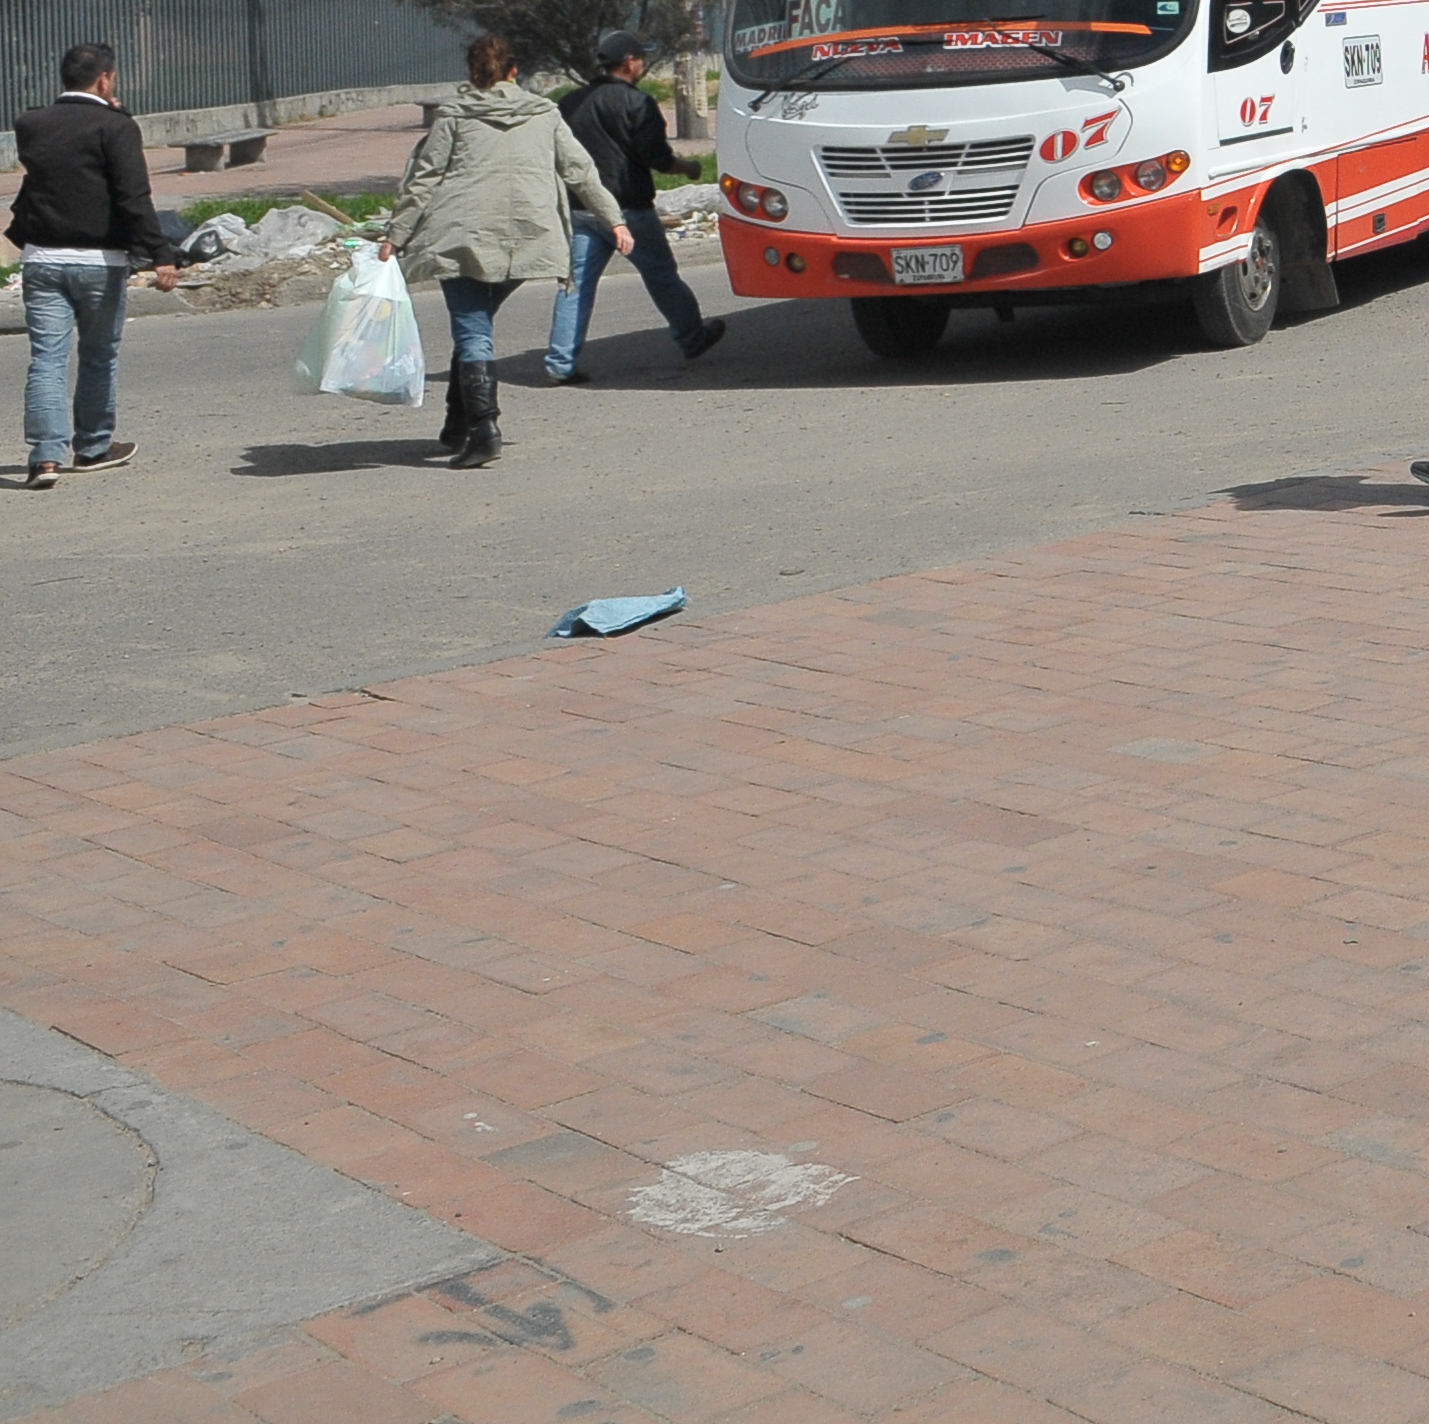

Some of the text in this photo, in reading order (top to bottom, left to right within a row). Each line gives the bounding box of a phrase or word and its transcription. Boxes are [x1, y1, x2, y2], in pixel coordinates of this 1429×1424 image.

[735, 26, 786, 47] MADRI
[812, 31, 1062, 60] NUEVA IMAGEN
[1344, 43, 1381, 77] SKN-709
[1240, 94, 1275, 127] 07
[1039, 106, 1122, 163] 07
[894, 252, 960, 275] SKN-709
